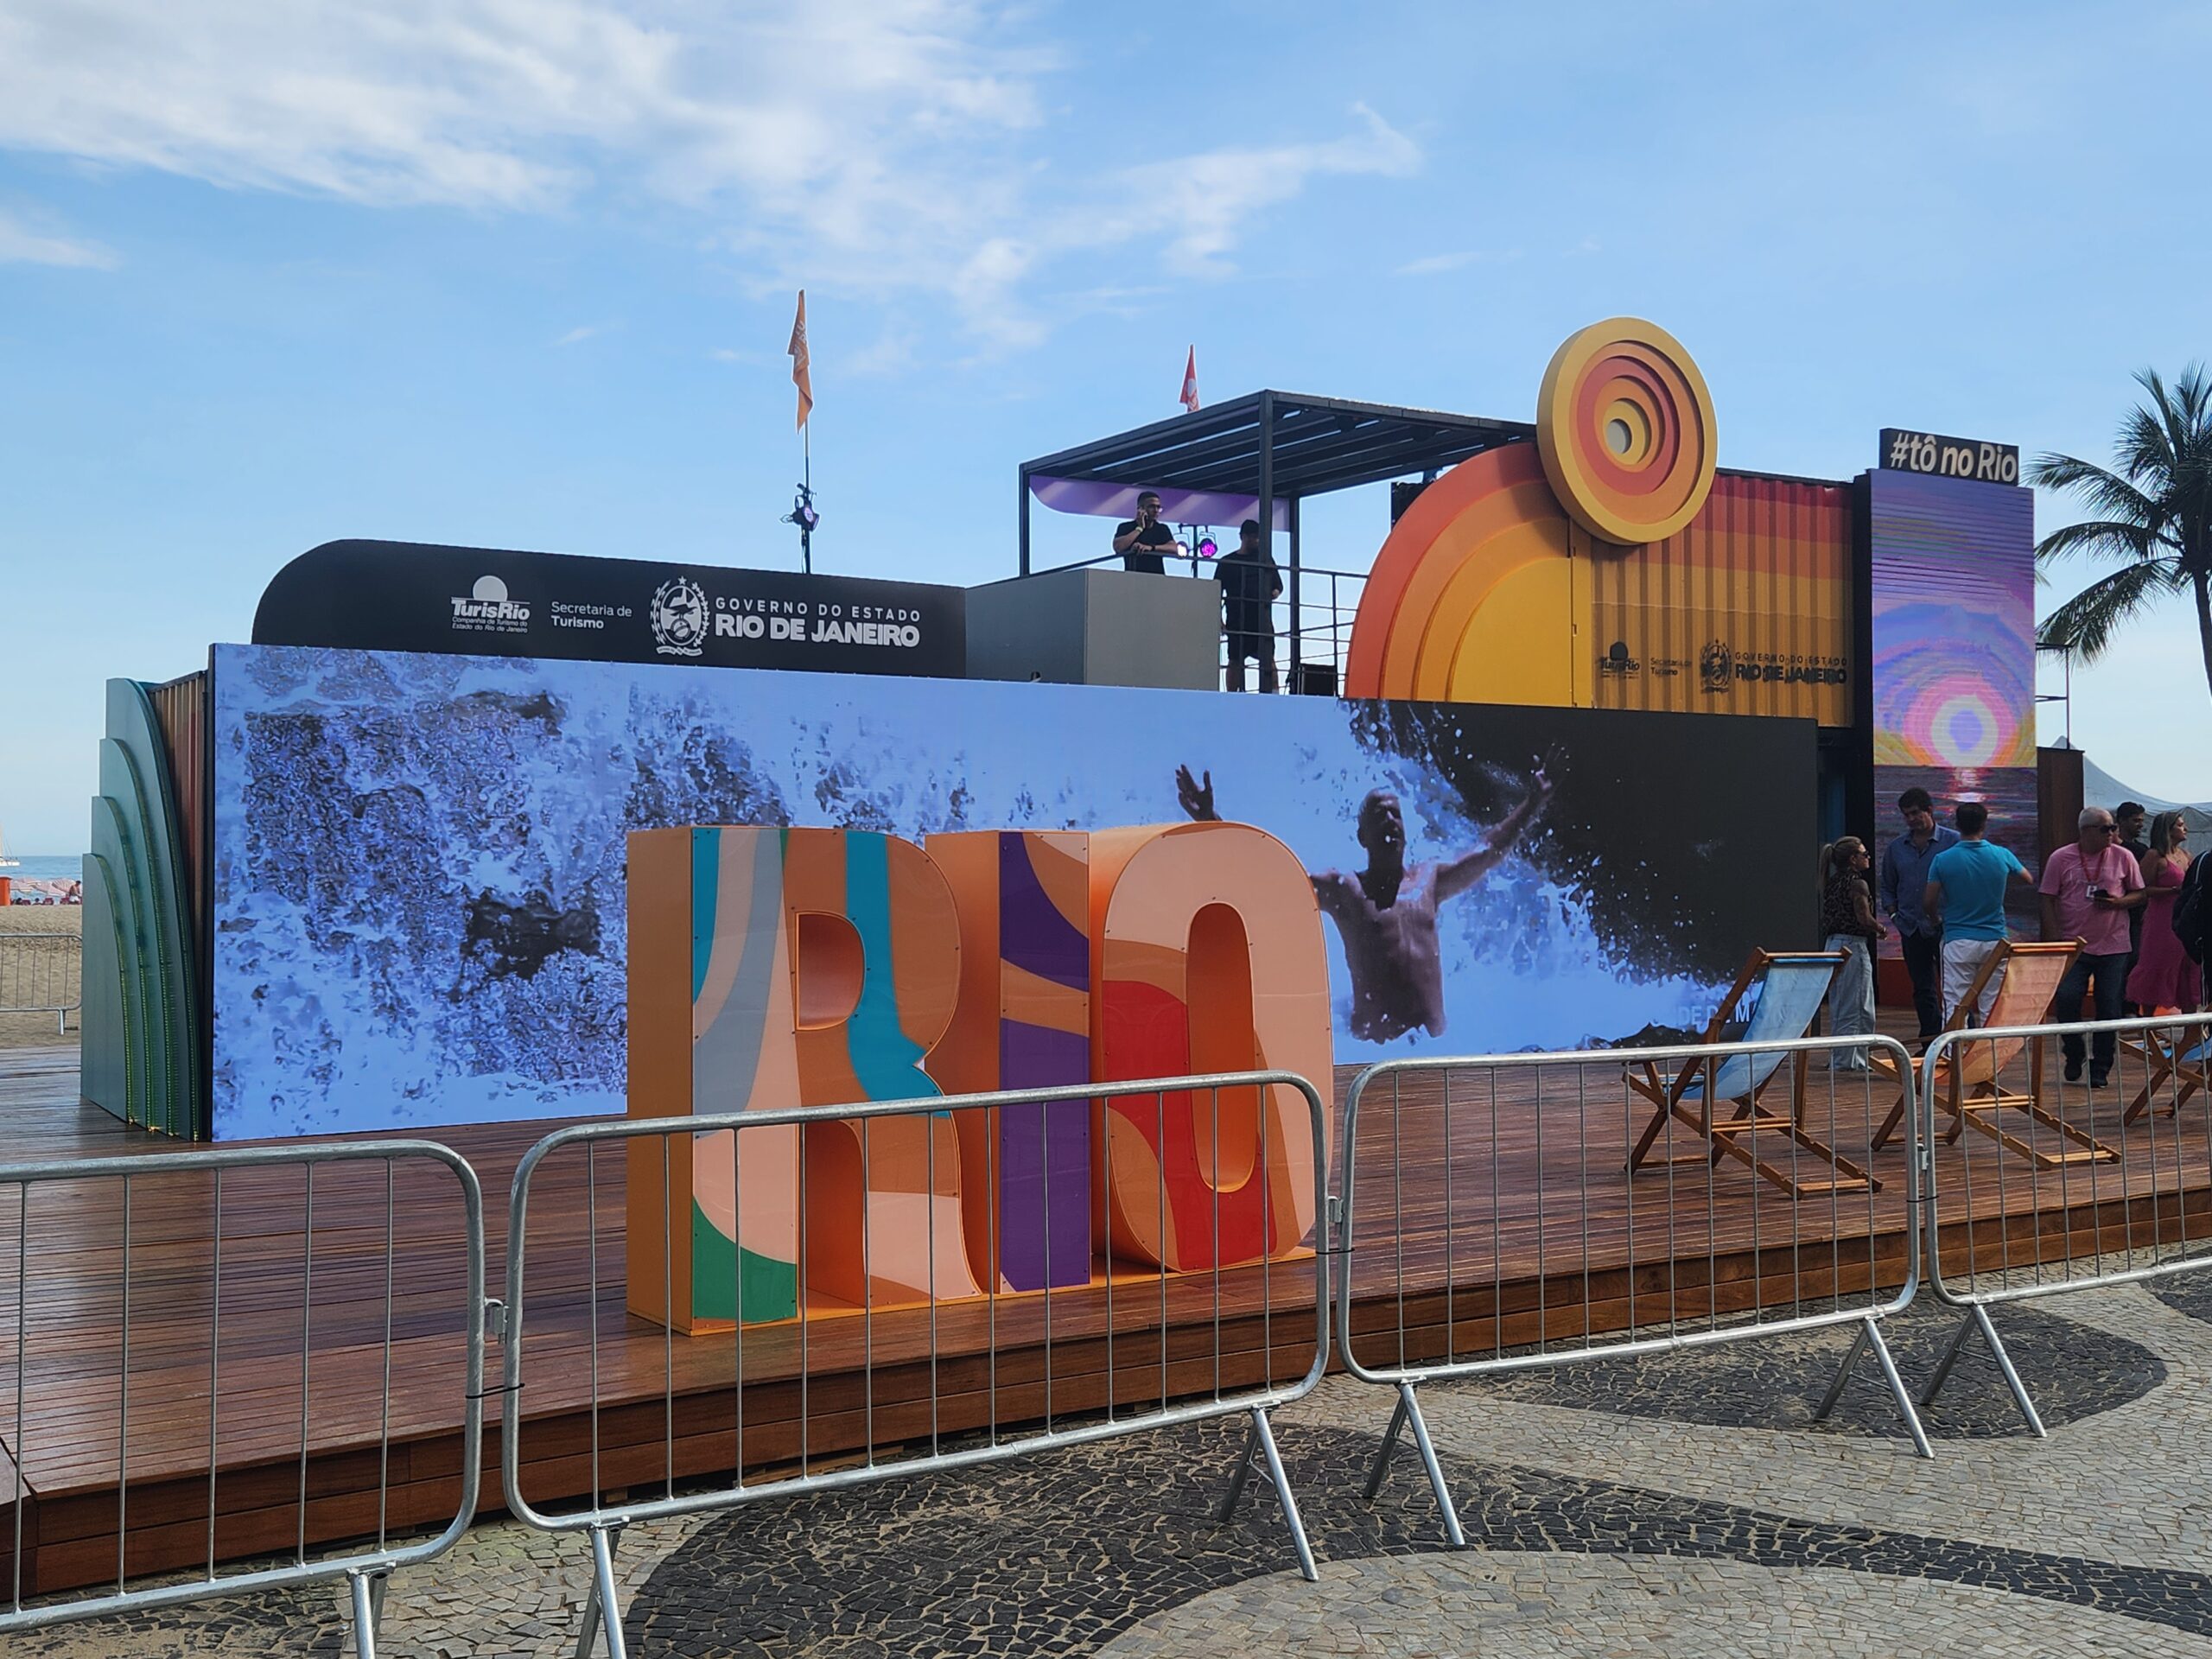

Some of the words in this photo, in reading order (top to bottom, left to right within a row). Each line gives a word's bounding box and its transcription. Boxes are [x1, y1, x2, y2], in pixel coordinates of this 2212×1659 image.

[1891, 432, 1937, 472] #tô
[1940, 446, 1974, 477] no
[1977, 442, 2017, 482] Rio
[451, 600, 531, 620] TurisRio
[551, 601, 614, 616] Secretaria
[616, 605, 632, 617] de
[715, 597, 808, 614] GOVERNO
[818, 603, 842, 617] DO
[852, 606, 920, 622] ESTADO
[452, 616, 486, 625] Companhia
[550, 614, 604, 629] Turismo
[715, 613, 765, 639] RIO
[770, 616, 806, 641] DE
[810, 620, 920, 647] JANEIRO
[1735, 652, 1785, 663] GOVERNO
[1808, 656, 1847, 666] ESTADO
[627, 822, 1334, 1336] RIO
